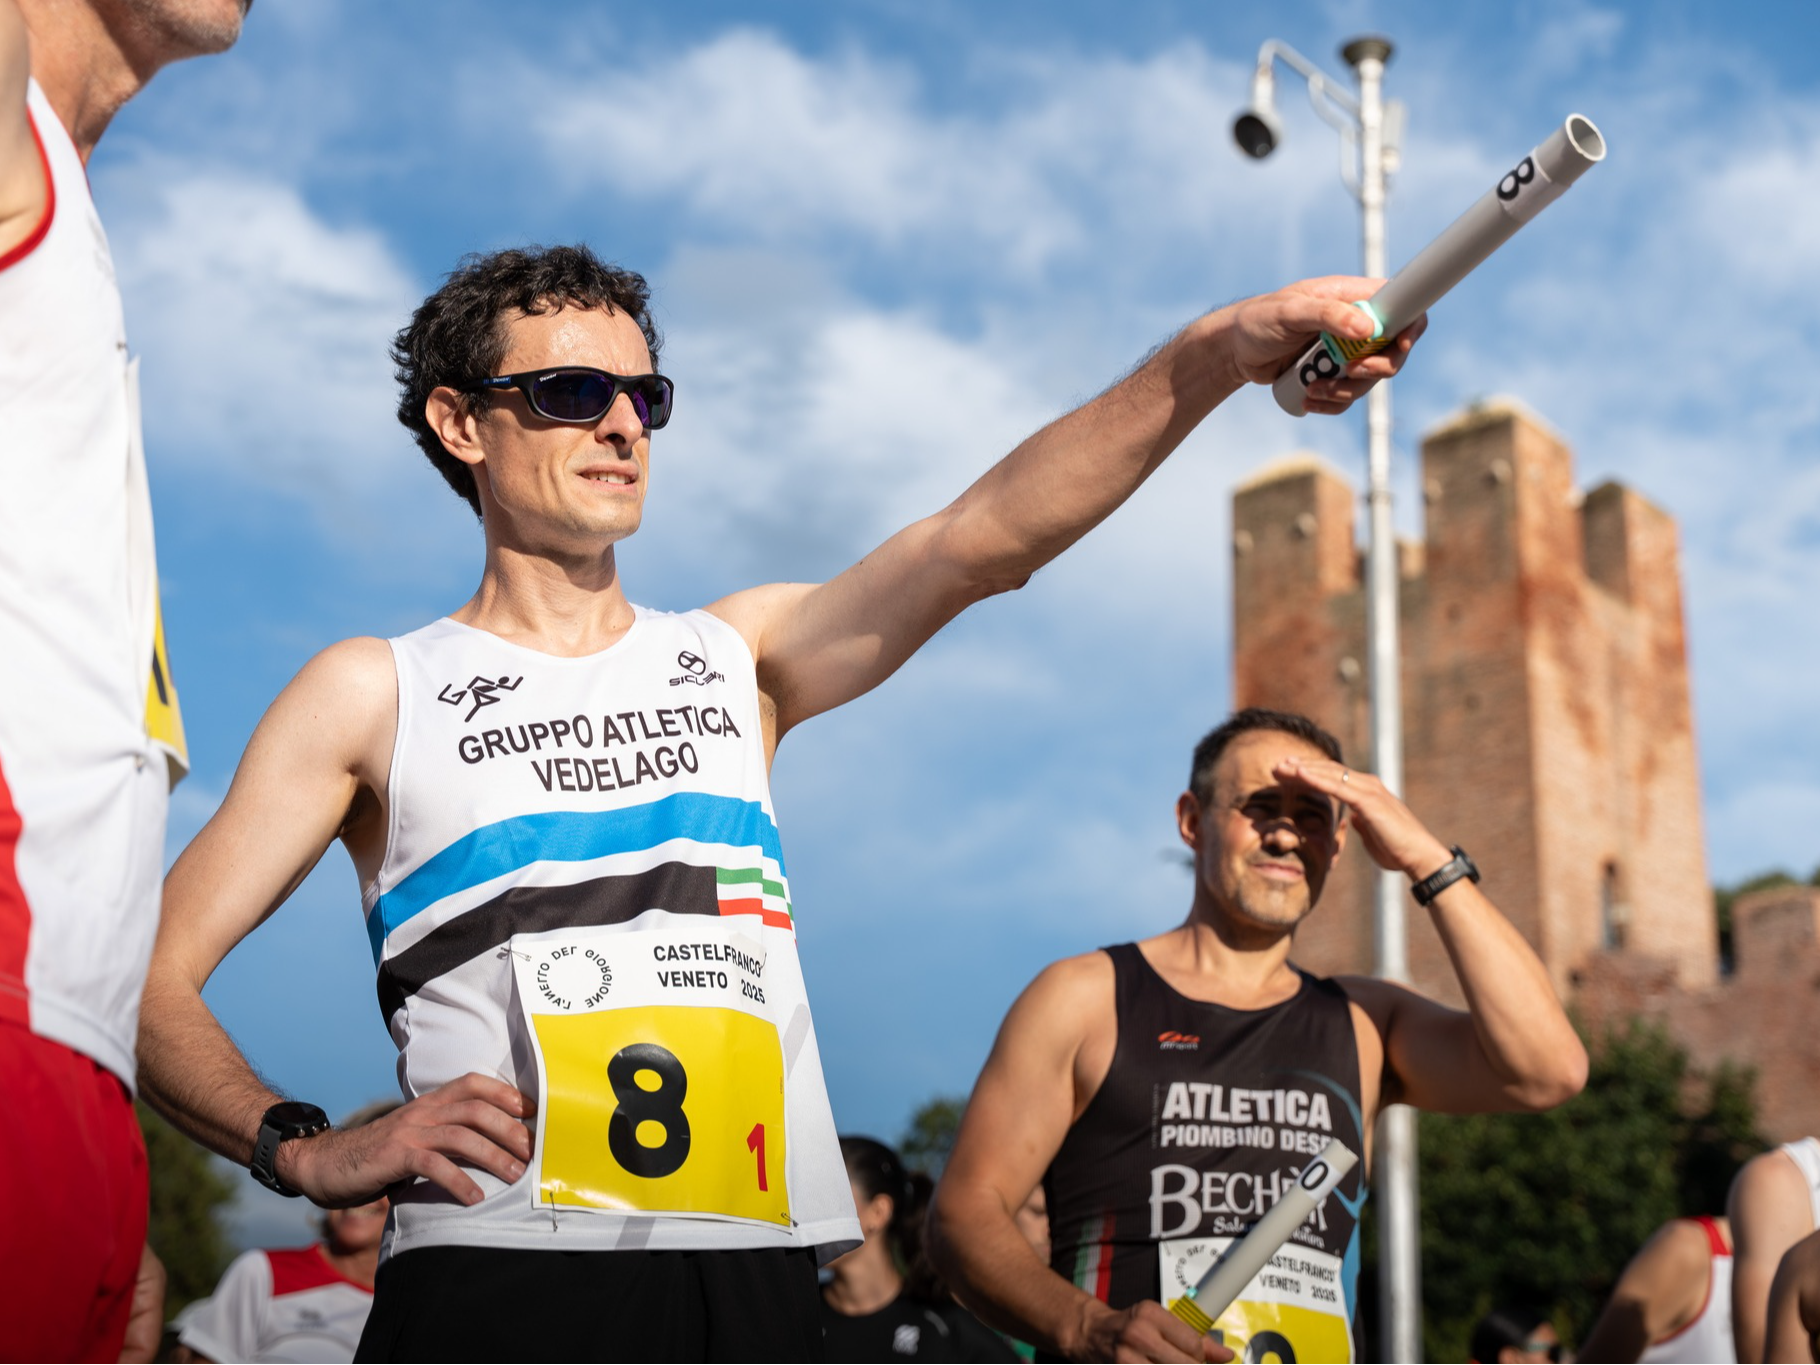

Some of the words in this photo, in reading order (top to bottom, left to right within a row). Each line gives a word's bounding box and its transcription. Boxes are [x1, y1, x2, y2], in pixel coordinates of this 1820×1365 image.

[1496, 155, 1535, 201] 8
[1299, 348, 1341, 387] 8
[458, 714, 593, 765] GRUPPO
[602, 705, 742, 748] ATLETICA
[530, 741, 699, 792] VEDELAGO
[653, 943, 761, 978] CASTELFRANCO
[657, 971, 728, 989] VENETO
[740, 978, 766, 1004] 2025
[606, 1042, 691, 1178] 8
[1161, 1082, 1332, 1131] ATLETICA
[746, 1123, 768, 1192] 1
[1160, 1124, 1274, 1149] PIOMBINO
[1267, 1255, 1335, 1283] ASTELFRANCO
